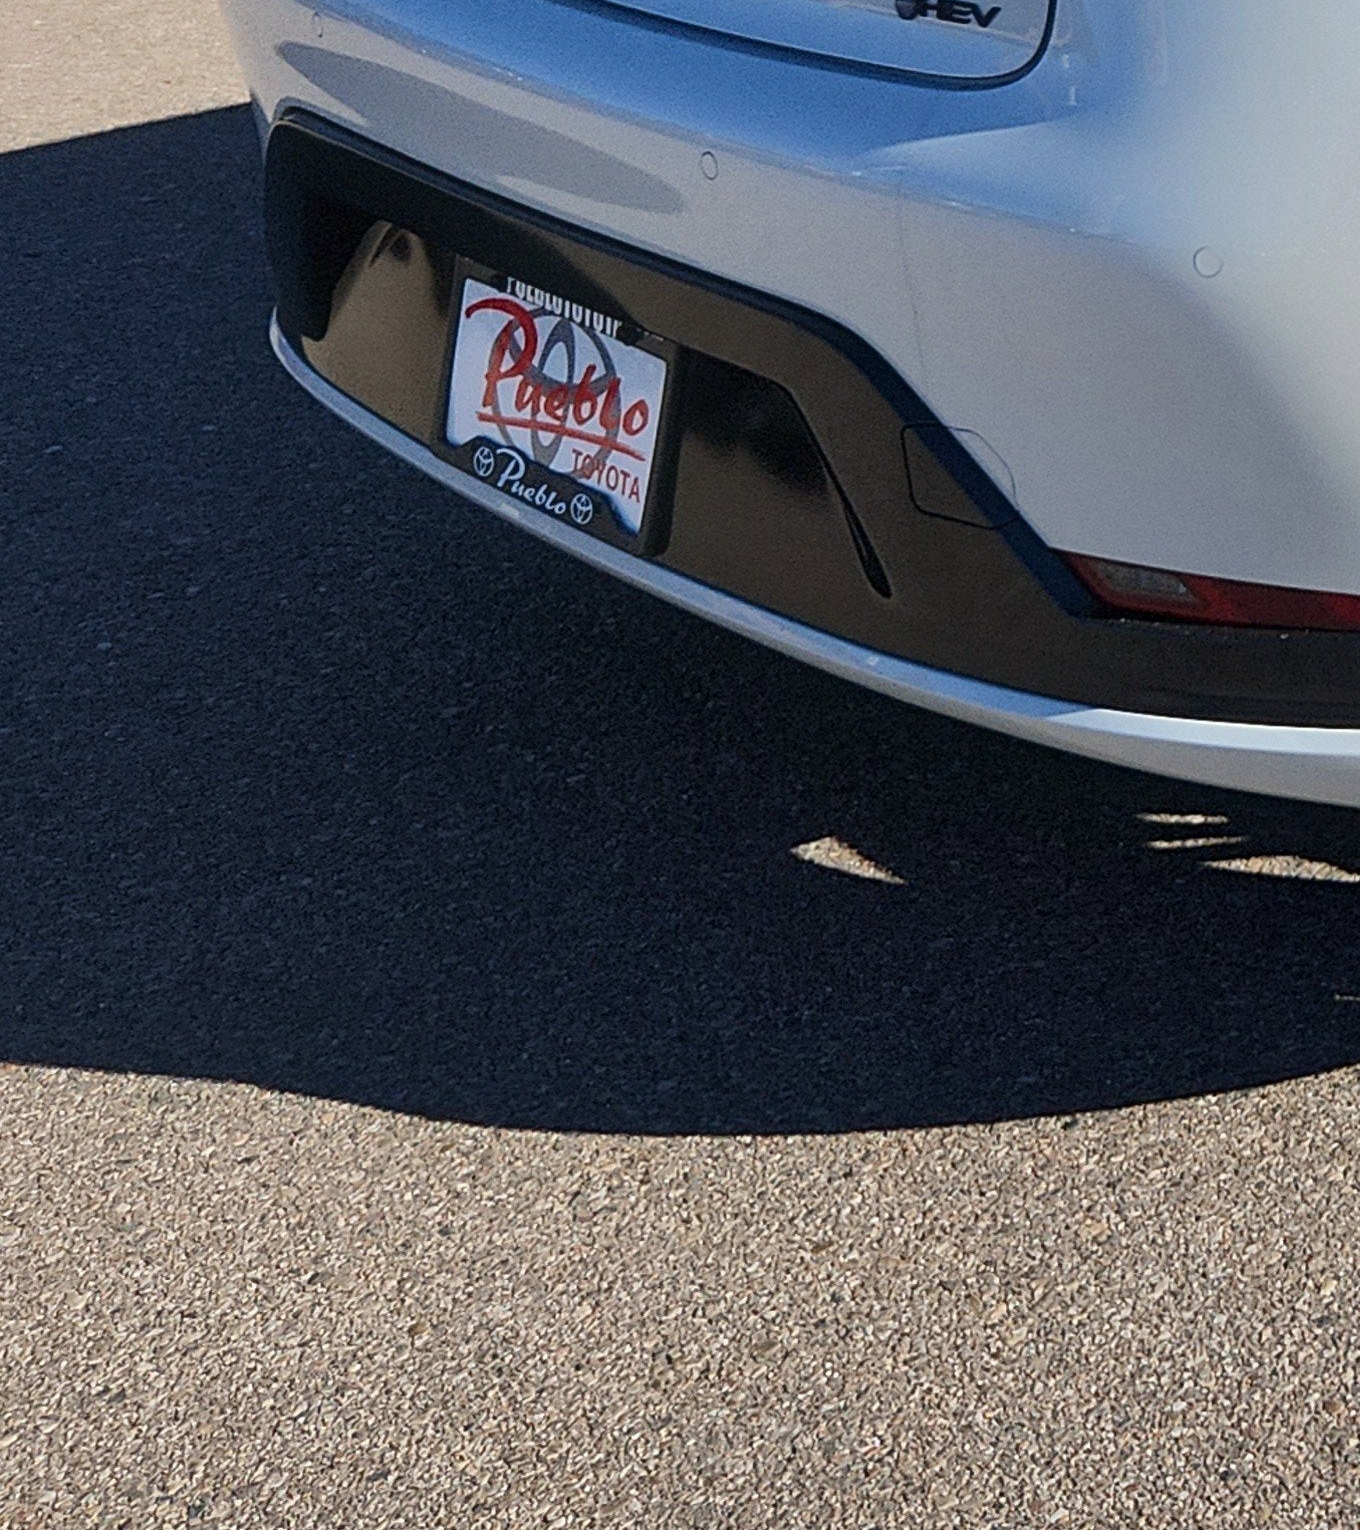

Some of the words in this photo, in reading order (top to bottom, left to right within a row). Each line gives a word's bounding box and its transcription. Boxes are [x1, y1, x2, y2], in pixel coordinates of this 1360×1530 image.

[465, 297, 649, 437] Pueblo
[496, 447, 568, 516] Pueblo
[572, 448, 641, 504] TOYOTA
